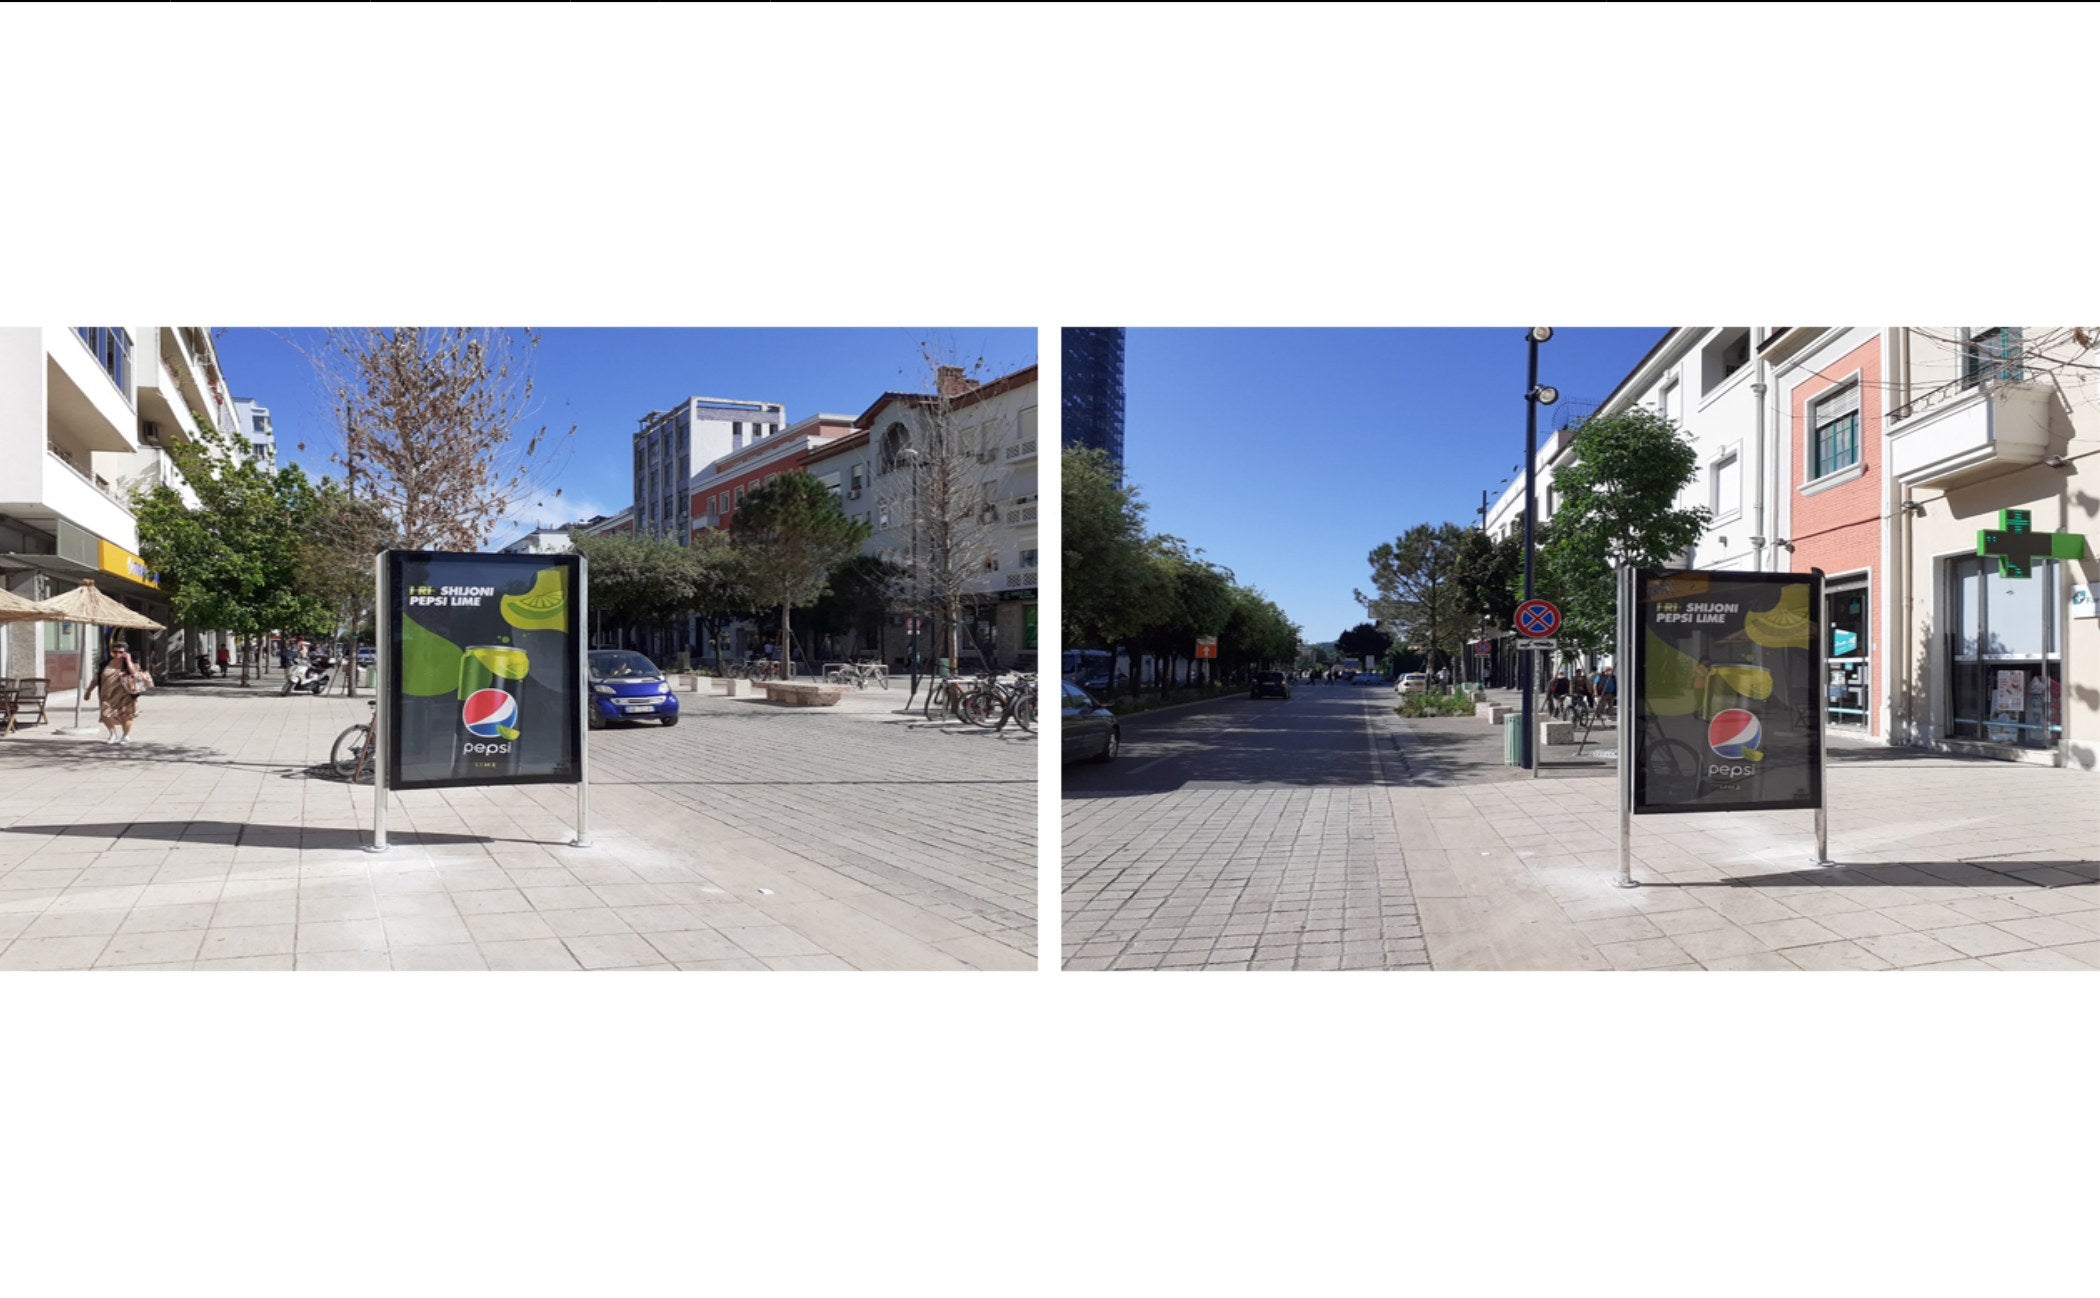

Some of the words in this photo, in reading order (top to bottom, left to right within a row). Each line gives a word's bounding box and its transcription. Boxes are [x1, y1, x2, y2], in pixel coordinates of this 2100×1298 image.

[440, 586, 494, 596] SHIJONI
[409, 596, 448, 606] PEPSI
[450, 597, 481, 606] LIME
[1686, 603, 1739, 613] SHIJONI
[1656, 613, 1693, 623] PEPSI
[1696, 613, 1726, 623] LIME
[463, 741, 512, 756] pepsi
[1708, 764, 1756, 778] pepsi
